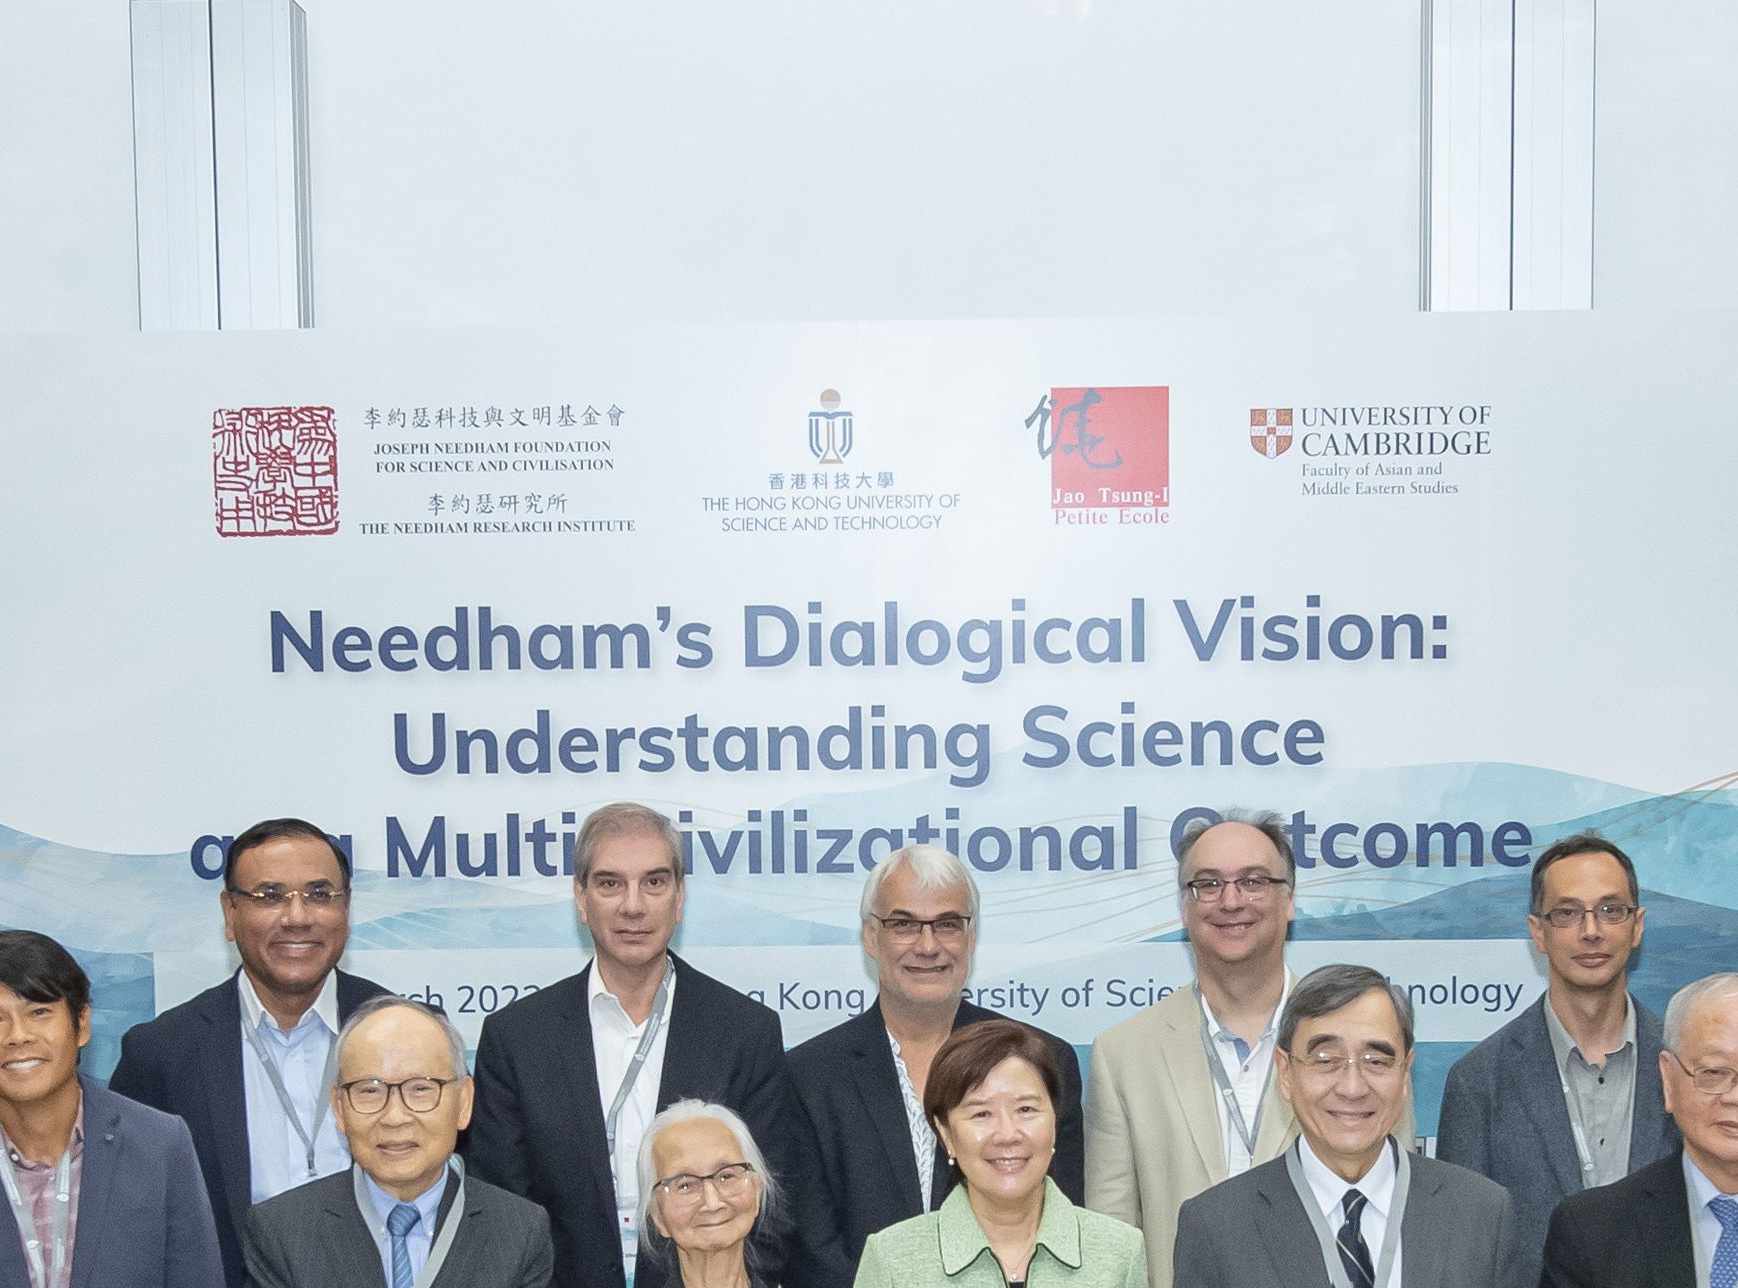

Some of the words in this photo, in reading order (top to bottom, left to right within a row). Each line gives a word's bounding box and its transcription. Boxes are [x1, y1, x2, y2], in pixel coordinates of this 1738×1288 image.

[363, 403, 626, 430] 李約瑟科技與文明基金會
[1301, 406, 1454, 427] UNIVERSITY
[1458, 405, 1492, 426] OF
[374, 443, 429, 455] JOSEPH
[434, 441, 509, 455] NEEDHAM
[513, 440, 612, 454] FOUNDATION
[1301, 431, 1492, 457] CAMBRIDGE
[376, 461, 406, 473] FOR
[410, 460, 474, 473] SCIENCE
[477, 460, 508, 472] AND
[512, 459, 614, 471] CIVILISATION
[1301, 463, 1350, 479] Faculty
[1355, 462, 1370, 476] of
[1374, 463, 1412, 476] Asian
[1417, 462, 1442, 476] and
[768, 471, 895, 490] 香港科技大學
[1301, 482, 1350, 496] Middle
[1355, 482, 1405, 495] Eastern
[1410, 481, 1459, 495] Studies
[427, 492, 568, 516] 李約瑟研究所
[702, 497, 730, 511] THE
[735, 496, 787, 511] HONG
[792, 495, 842, 511] KONG
[847, 494, 934, 510] UNIVERSITY
[939, 494, 962, 509] OF
[1052, 488, 1085, 504] Jao
[1098, 486, 1169, 507] Tsung-I
[722, 517, 788, 532] SCIENCE
[792, 516, 829, 531] AND
[833, 515, 943, 531] TECHNOLOGY
[1054, 509, 1108, 525] Petite
[1119, 508, 1170, 524] Ecole
[359, 523, 390, 535] THE
[393, 522, 469, 535] NEEDHAM
[472, 521, 552, 534] RESEARCH
[557, 520, 637, 533] INSTITUTE
[745, 599, 1146, 685] Dialogical
[1173, 594, 1449, 665] Vision:
[393, 704, 991, 788] Understanding
[1021, 701, 1326, 770] Science
[385, 805, 1138, 878] Multiivilizational
[779, 982, 865, 1017] Kong
[1062, 978, 1094, 1008] of
[1106, 978, 1183, 1007] Scie
[1386, 975, 1524, 1013] nology
